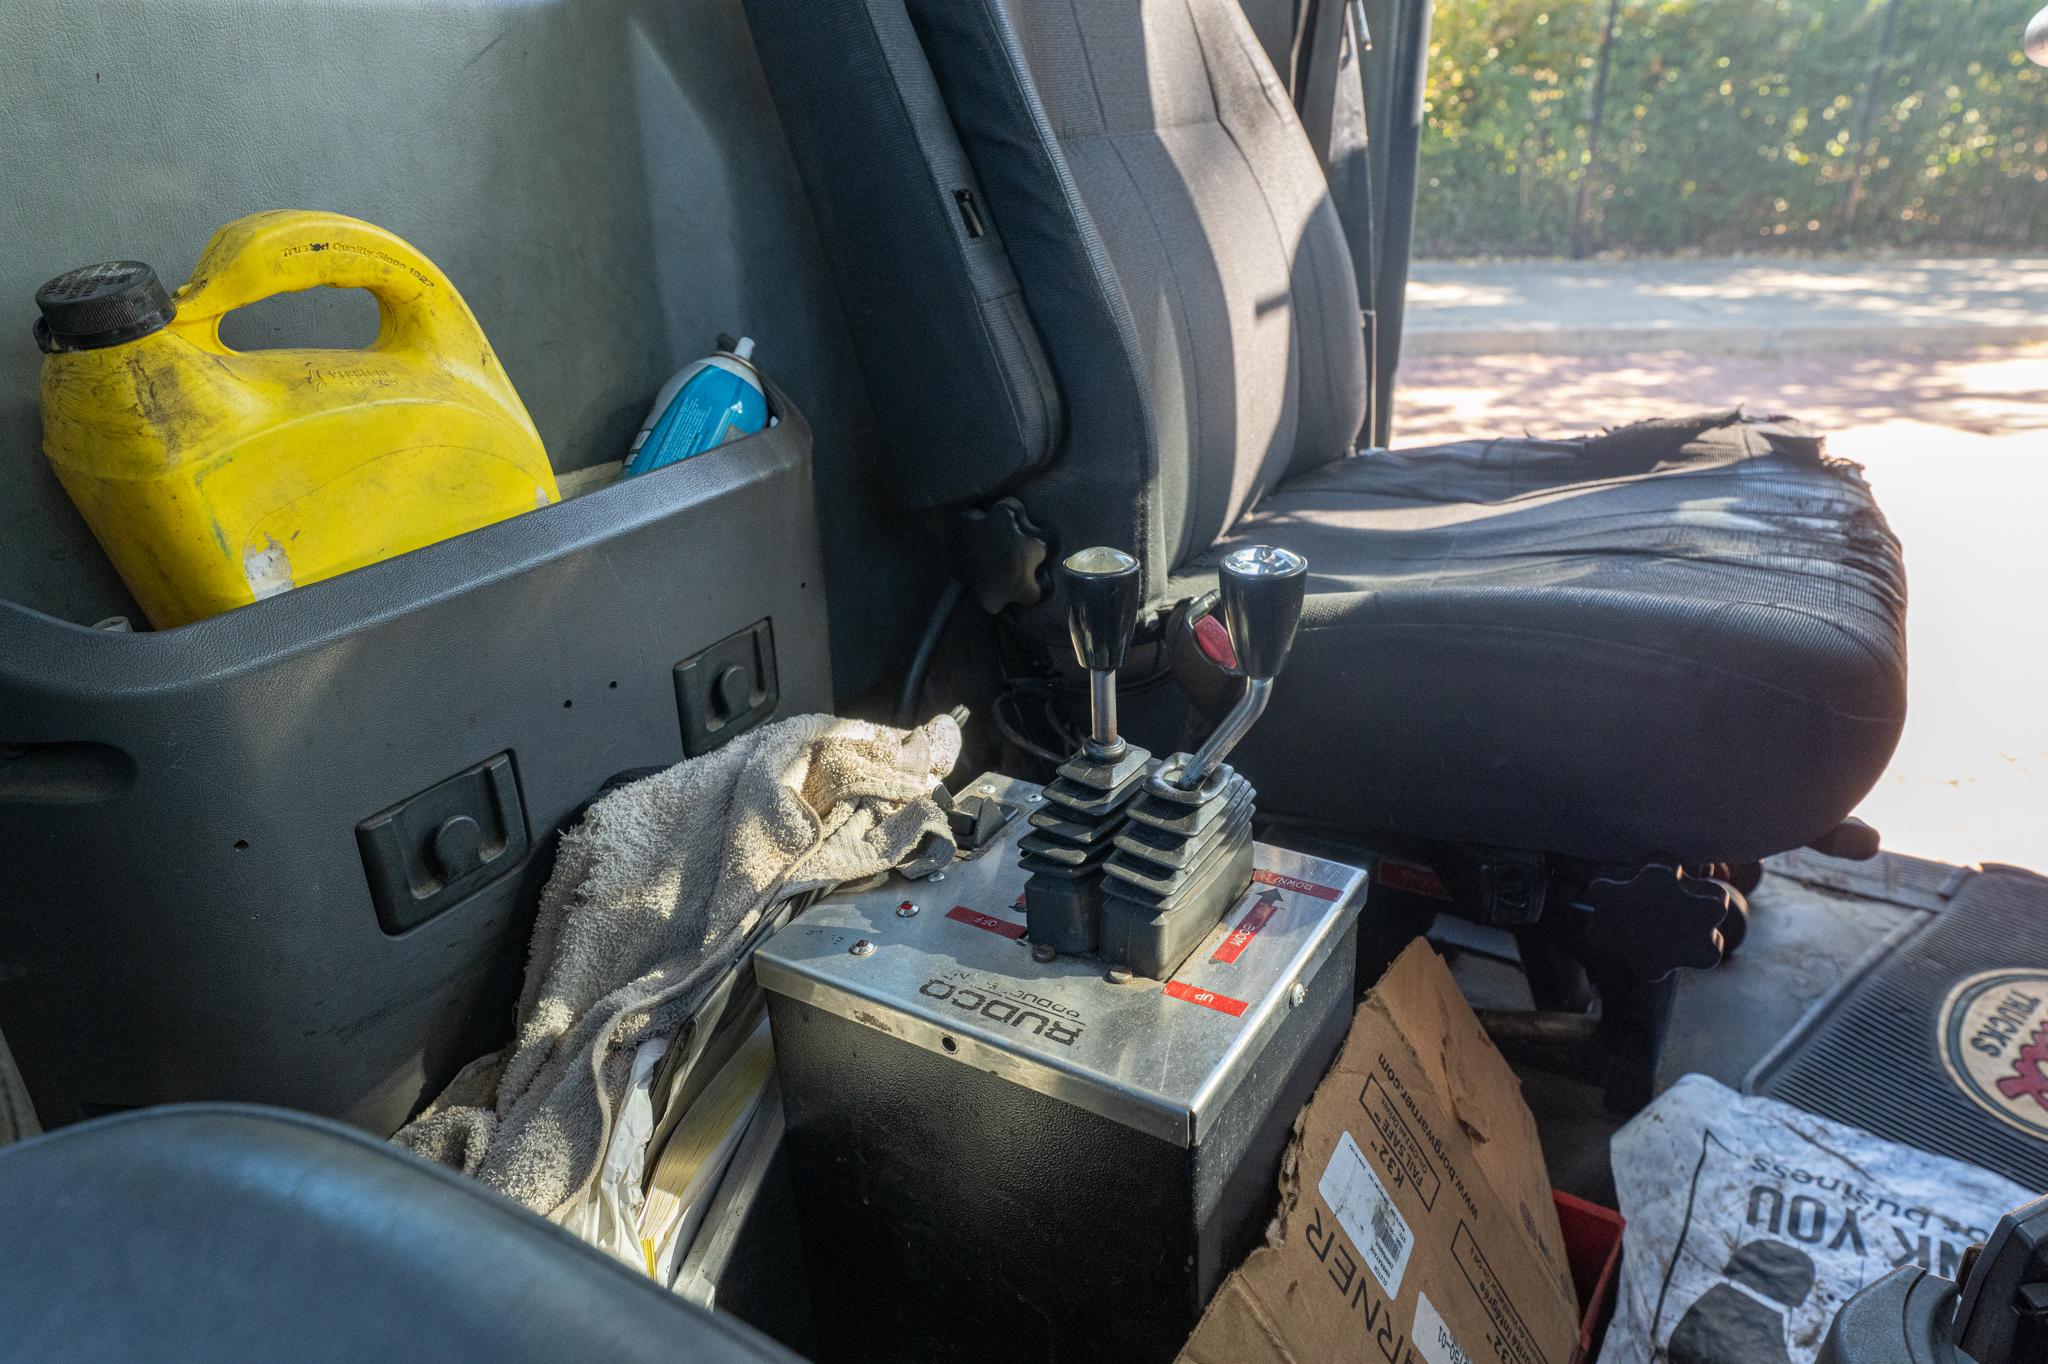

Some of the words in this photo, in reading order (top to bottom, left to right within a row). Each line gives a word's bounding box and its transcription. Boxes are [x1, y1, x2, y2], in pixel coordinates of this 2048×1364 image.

[333, 242, 373, 258] Quality
[375, 251, 406, 270] Since
[409, 267, 435, 288] 1927
[1278, 877, 1313, 891] DOWN
[973, 915, 998, 929] OFF
[1233, 923, 1255, 948] BOOM
[919, 979, 1084, 1046] RUDCO
[1194, 993, 1214, 1005] UP
[1971, 990, 2041, 1057] TRUCKS
[1377, 1053, 1478, 1220] www.borgwarner.com
[1404, 1156, 1424, 1187] FAIL
[1750, 1155, 1931, 1232] business
[1746, 1185, 1867, 1258] YOU
[1891, 1226, 1960, 1278] NK
[1306, 1207, 1412, 1364] RNER
